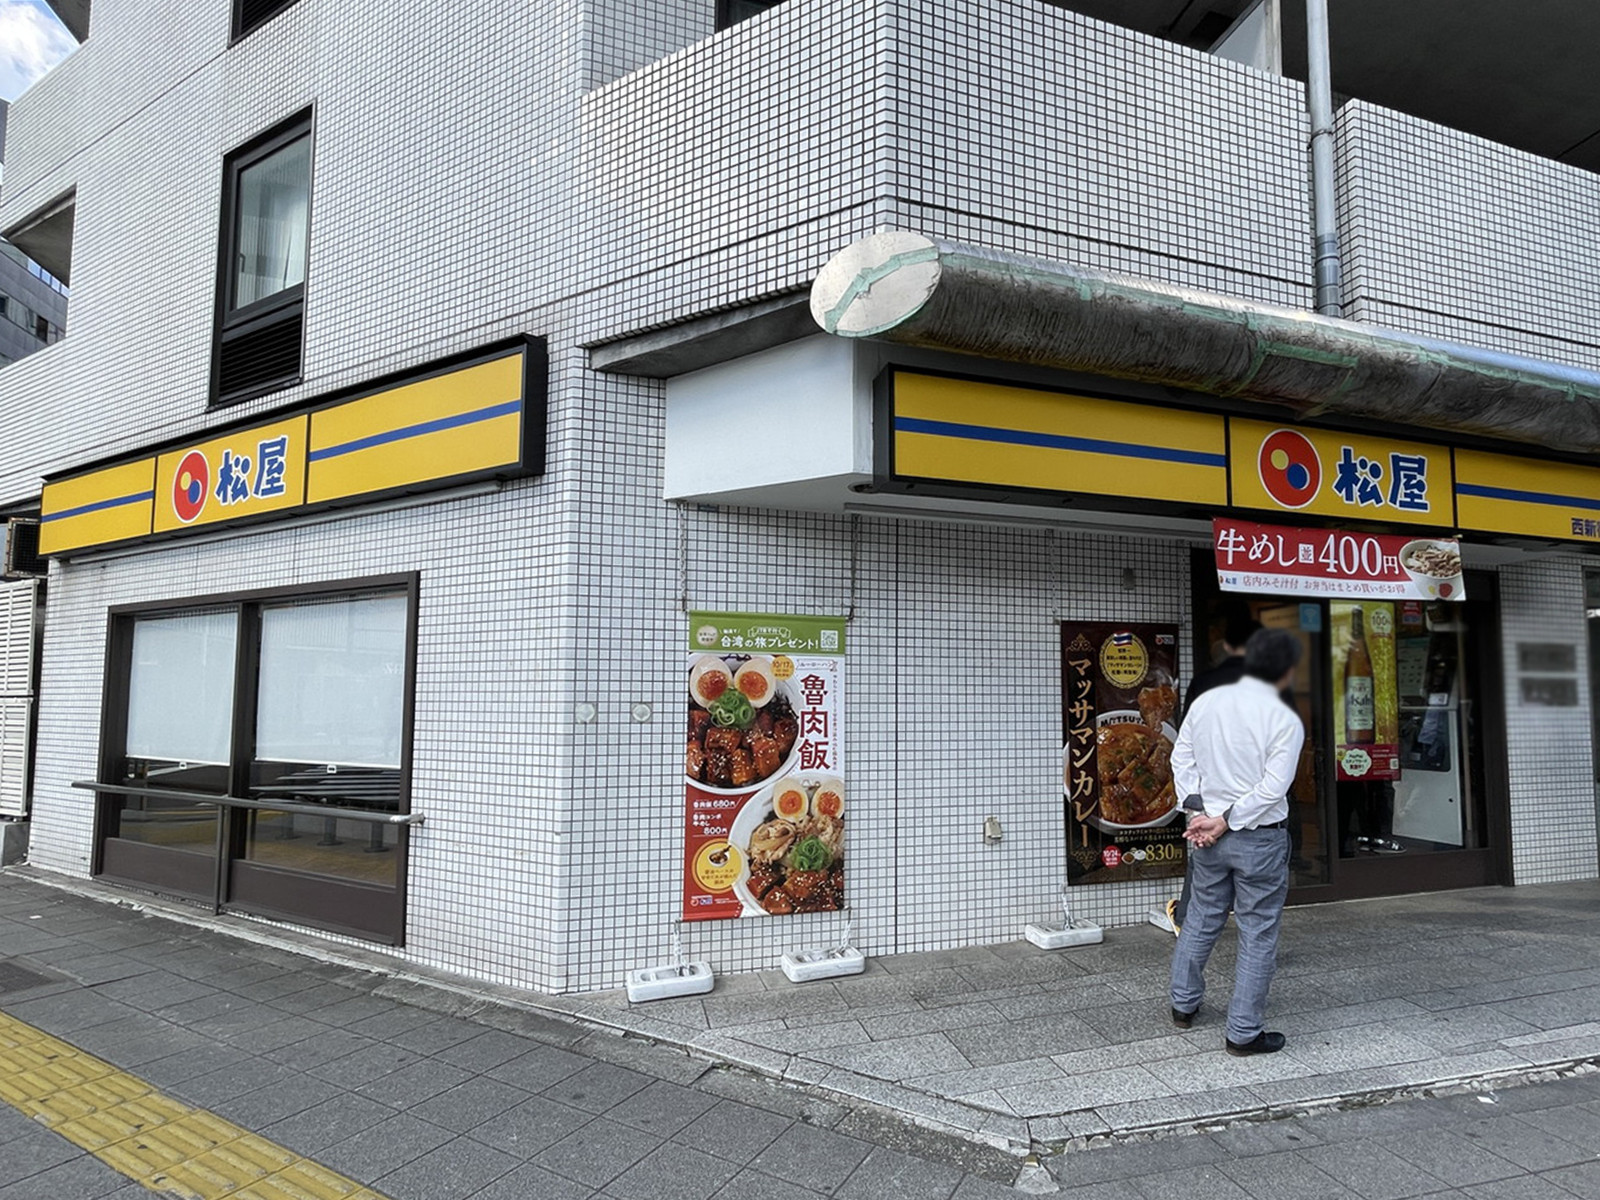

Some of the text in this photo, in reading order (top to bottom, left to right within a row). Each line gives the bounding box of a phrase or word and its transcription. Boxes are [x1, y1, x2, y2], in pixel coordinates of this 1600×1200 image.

[214, 434, 288, 506] 松屋
[1332, 445, 1430, 513] 松屋
[1217, 528, 1298, 567] 牛めし
[1319, 533, 1400, 577] 400円
[1242, 574, 1299, 590] 店内みそ汁付
[798, 674, 831, 770] 魯肉飯
[1068, 657, 1098, 849] マッサマンカレー
[1145, 843, 1183, 861] 830円
